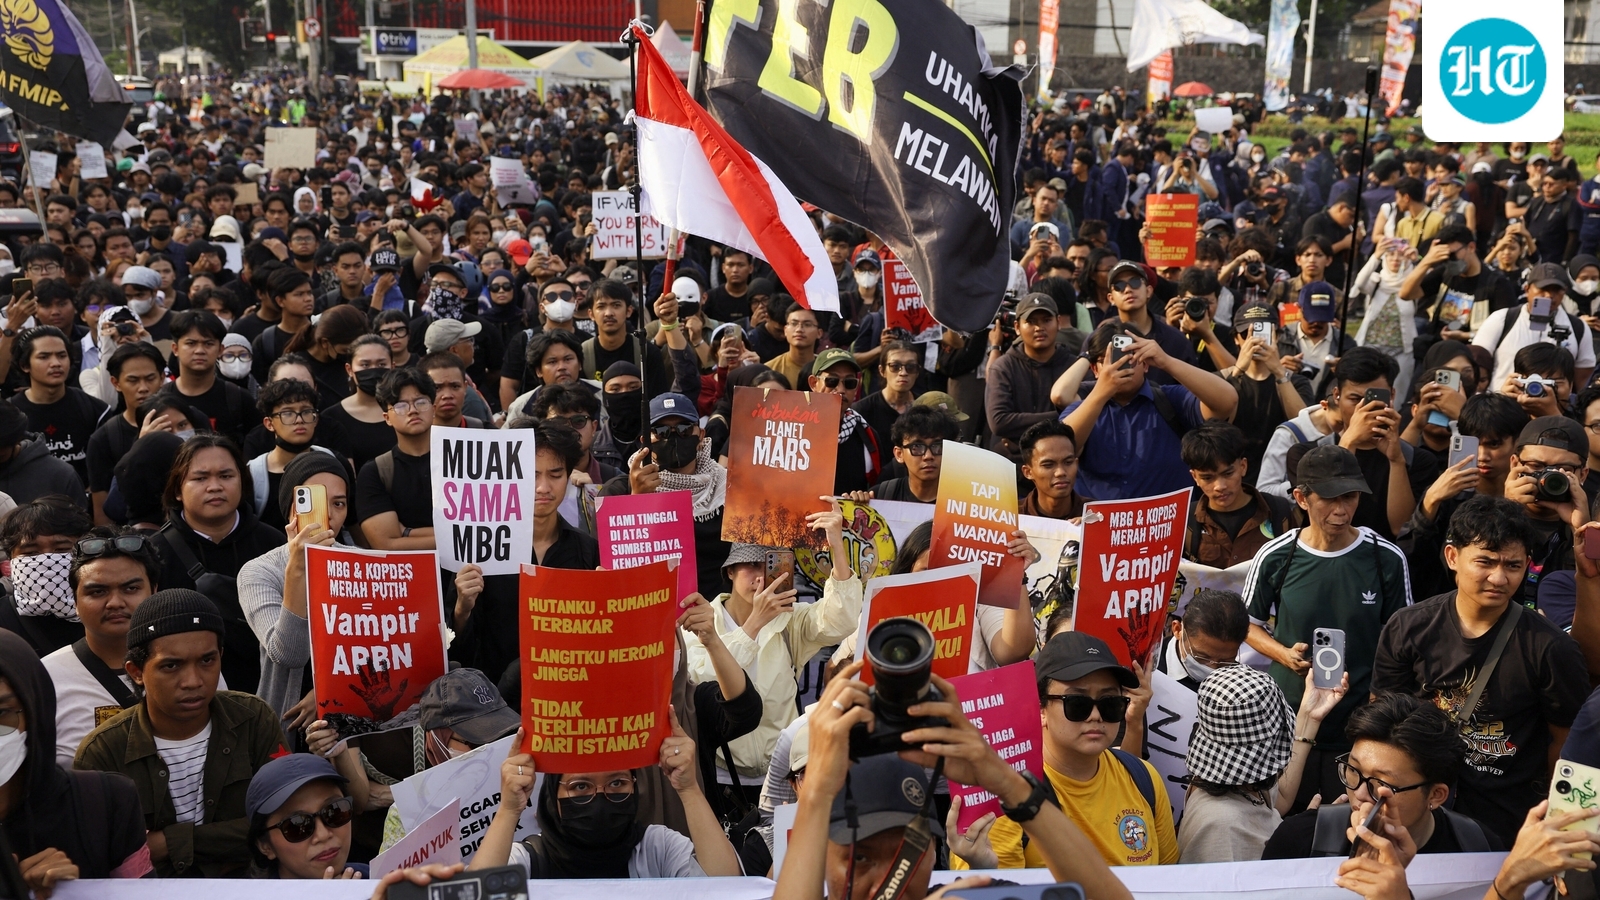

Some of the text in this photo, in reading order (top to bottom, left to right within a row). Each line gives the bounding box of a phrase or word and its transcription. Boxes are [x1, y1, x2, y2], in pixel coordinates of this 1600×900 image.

[388, 33, 412, 46] triv
[704, 0, 898, 145] FEB
[9, 73, 70, 111] FMIP
[926, 51, 1000, 165] UHAMKA
[894, 121, 1001, 237] MELAWAN
[597, 197, 611, 209] IF
[595, 215, 660, 229] YOU BRN
[596, 235, 634, 249] WITH
[765, 420, 804, 440] PLANET
[443, 439, 523, 480] MUAK
[752, 436, 811, 472] MARS
[443, 481, 522, 522] SAMA
[971, 481, 999, 501] TAPI
[609, 511, 678, 527] KAMI TINGGAL
[946, 499, 1016, 527] INI BUKAN
[1109, 502, 1177, 529] MBG & KOPDES
[452, 524, 511, 563] MBG
[610, 528, 649, 541] DI ATAS
[953, 522, 1008, 546] WARNA
[1111, 521, 1172, 547] MERAH PUTIH
[611, 538, 683, 556] SUMBER DAYA.
[948, 544, 1005, 567] SUNSET
[327, 560, 414, 581] MBG & KOPDES
[612, 556, 651, 570] KENAPA
[1099, 545, 1174, 583] Vampir
[329, 579, 408, 601] MERAH PUTIH
[528, 597, 596, 615] HUTANKU
[607, 587, 670, 613] RUMAHKU
[1103, 581, 1166, 619] APBN
[321, 603, 420, 642] Vampir
[531, 615, 614, 634] TERBAKAR
[332, 642, 413, 676] APBN
[530, 641, 665, 665] LANGITKU MERONA
[532, 666, 589, 682] JINGGA
[531, 698, 583, 717] TIDAK
[977, 693, 1004, 711] AKAN
[531, 711, 655, 736] TERLIHAT KAH
[1477, 720, 1504, 736] 32
[531, 731, 650, 755] DARI ISTANA?
[991, 727, 1015, 745] JAGA
[997, 740, 1033, 760] NEGARA
[430, 825, 454, 854] YUK
